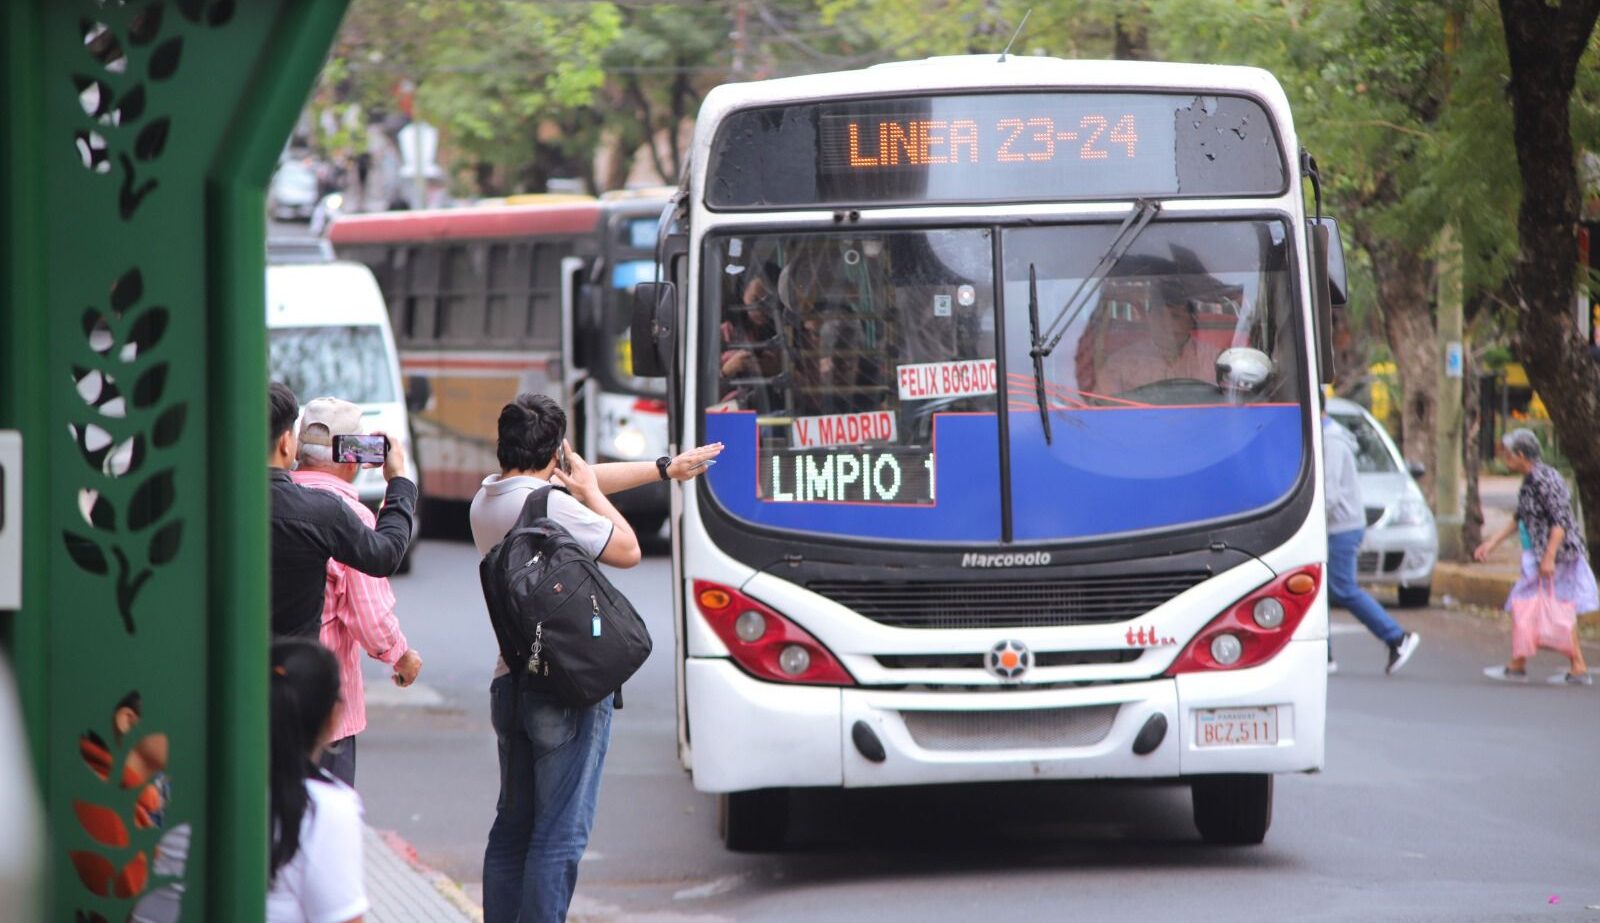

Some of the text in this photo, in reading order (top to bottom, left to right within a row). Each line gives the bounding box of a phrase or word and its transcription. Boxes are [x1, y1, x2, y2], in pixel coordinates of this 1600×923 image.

[849, 113, 1138, 167] LINEA 23-24
[900, 366, 938, 396] FELIX
[796, 411, 892, 447] V. MADRID
[772, 453, 901, 501] LIMPIO
